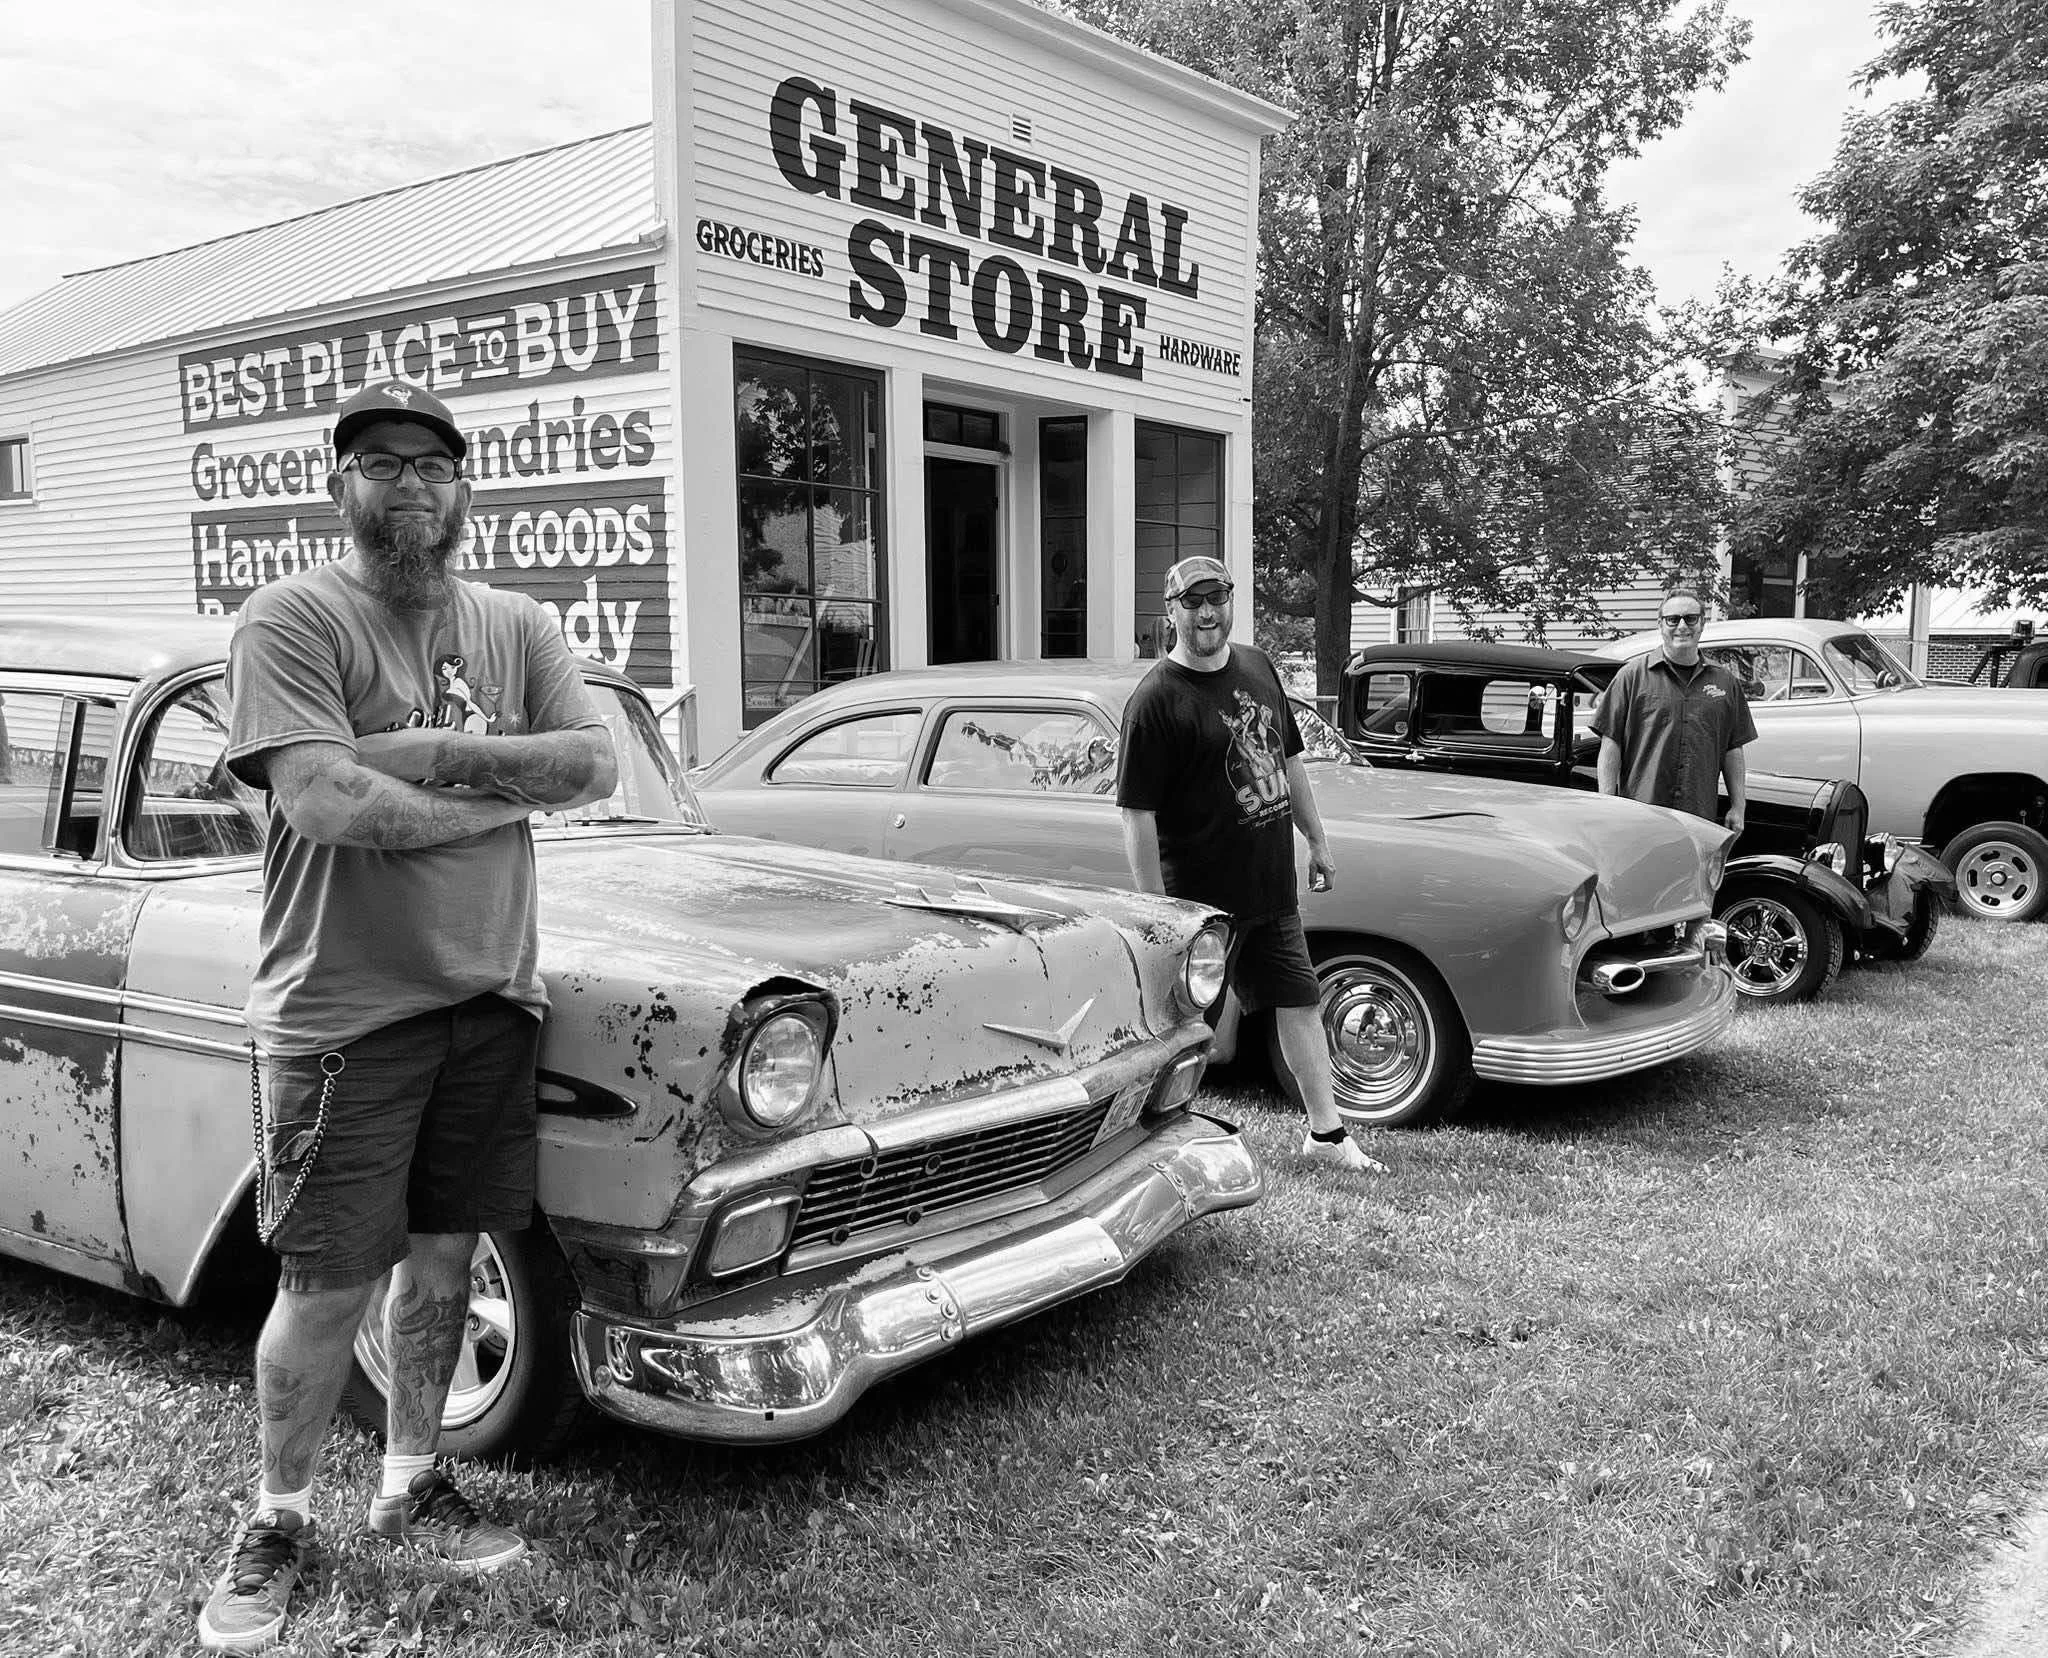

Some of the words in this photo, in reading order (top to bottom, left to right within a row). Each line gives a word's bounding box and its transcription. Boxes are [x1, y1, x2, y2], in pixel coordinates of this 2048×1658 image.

[769, 76, 1199, 299] GENERAL
[696, 219, 824, 278] GROCERIES
[847, 218, 1147, 382] STORE
[184, 347, 293, 424] BEST
[298, 316, 464, 404] PLACE
[468, 329, 508, 368] TO
[509, 282, 647, 379] BUY
[1159, 334, 1241, 376] HARDWARE
[191, 428, 336, 502] Groceri
[462, 395, 656, 481] ndries
[200, 518, 354, 586] Hardw
[454, 514, 501, 571] RY
[508, 503, 655, 569] GOODS
